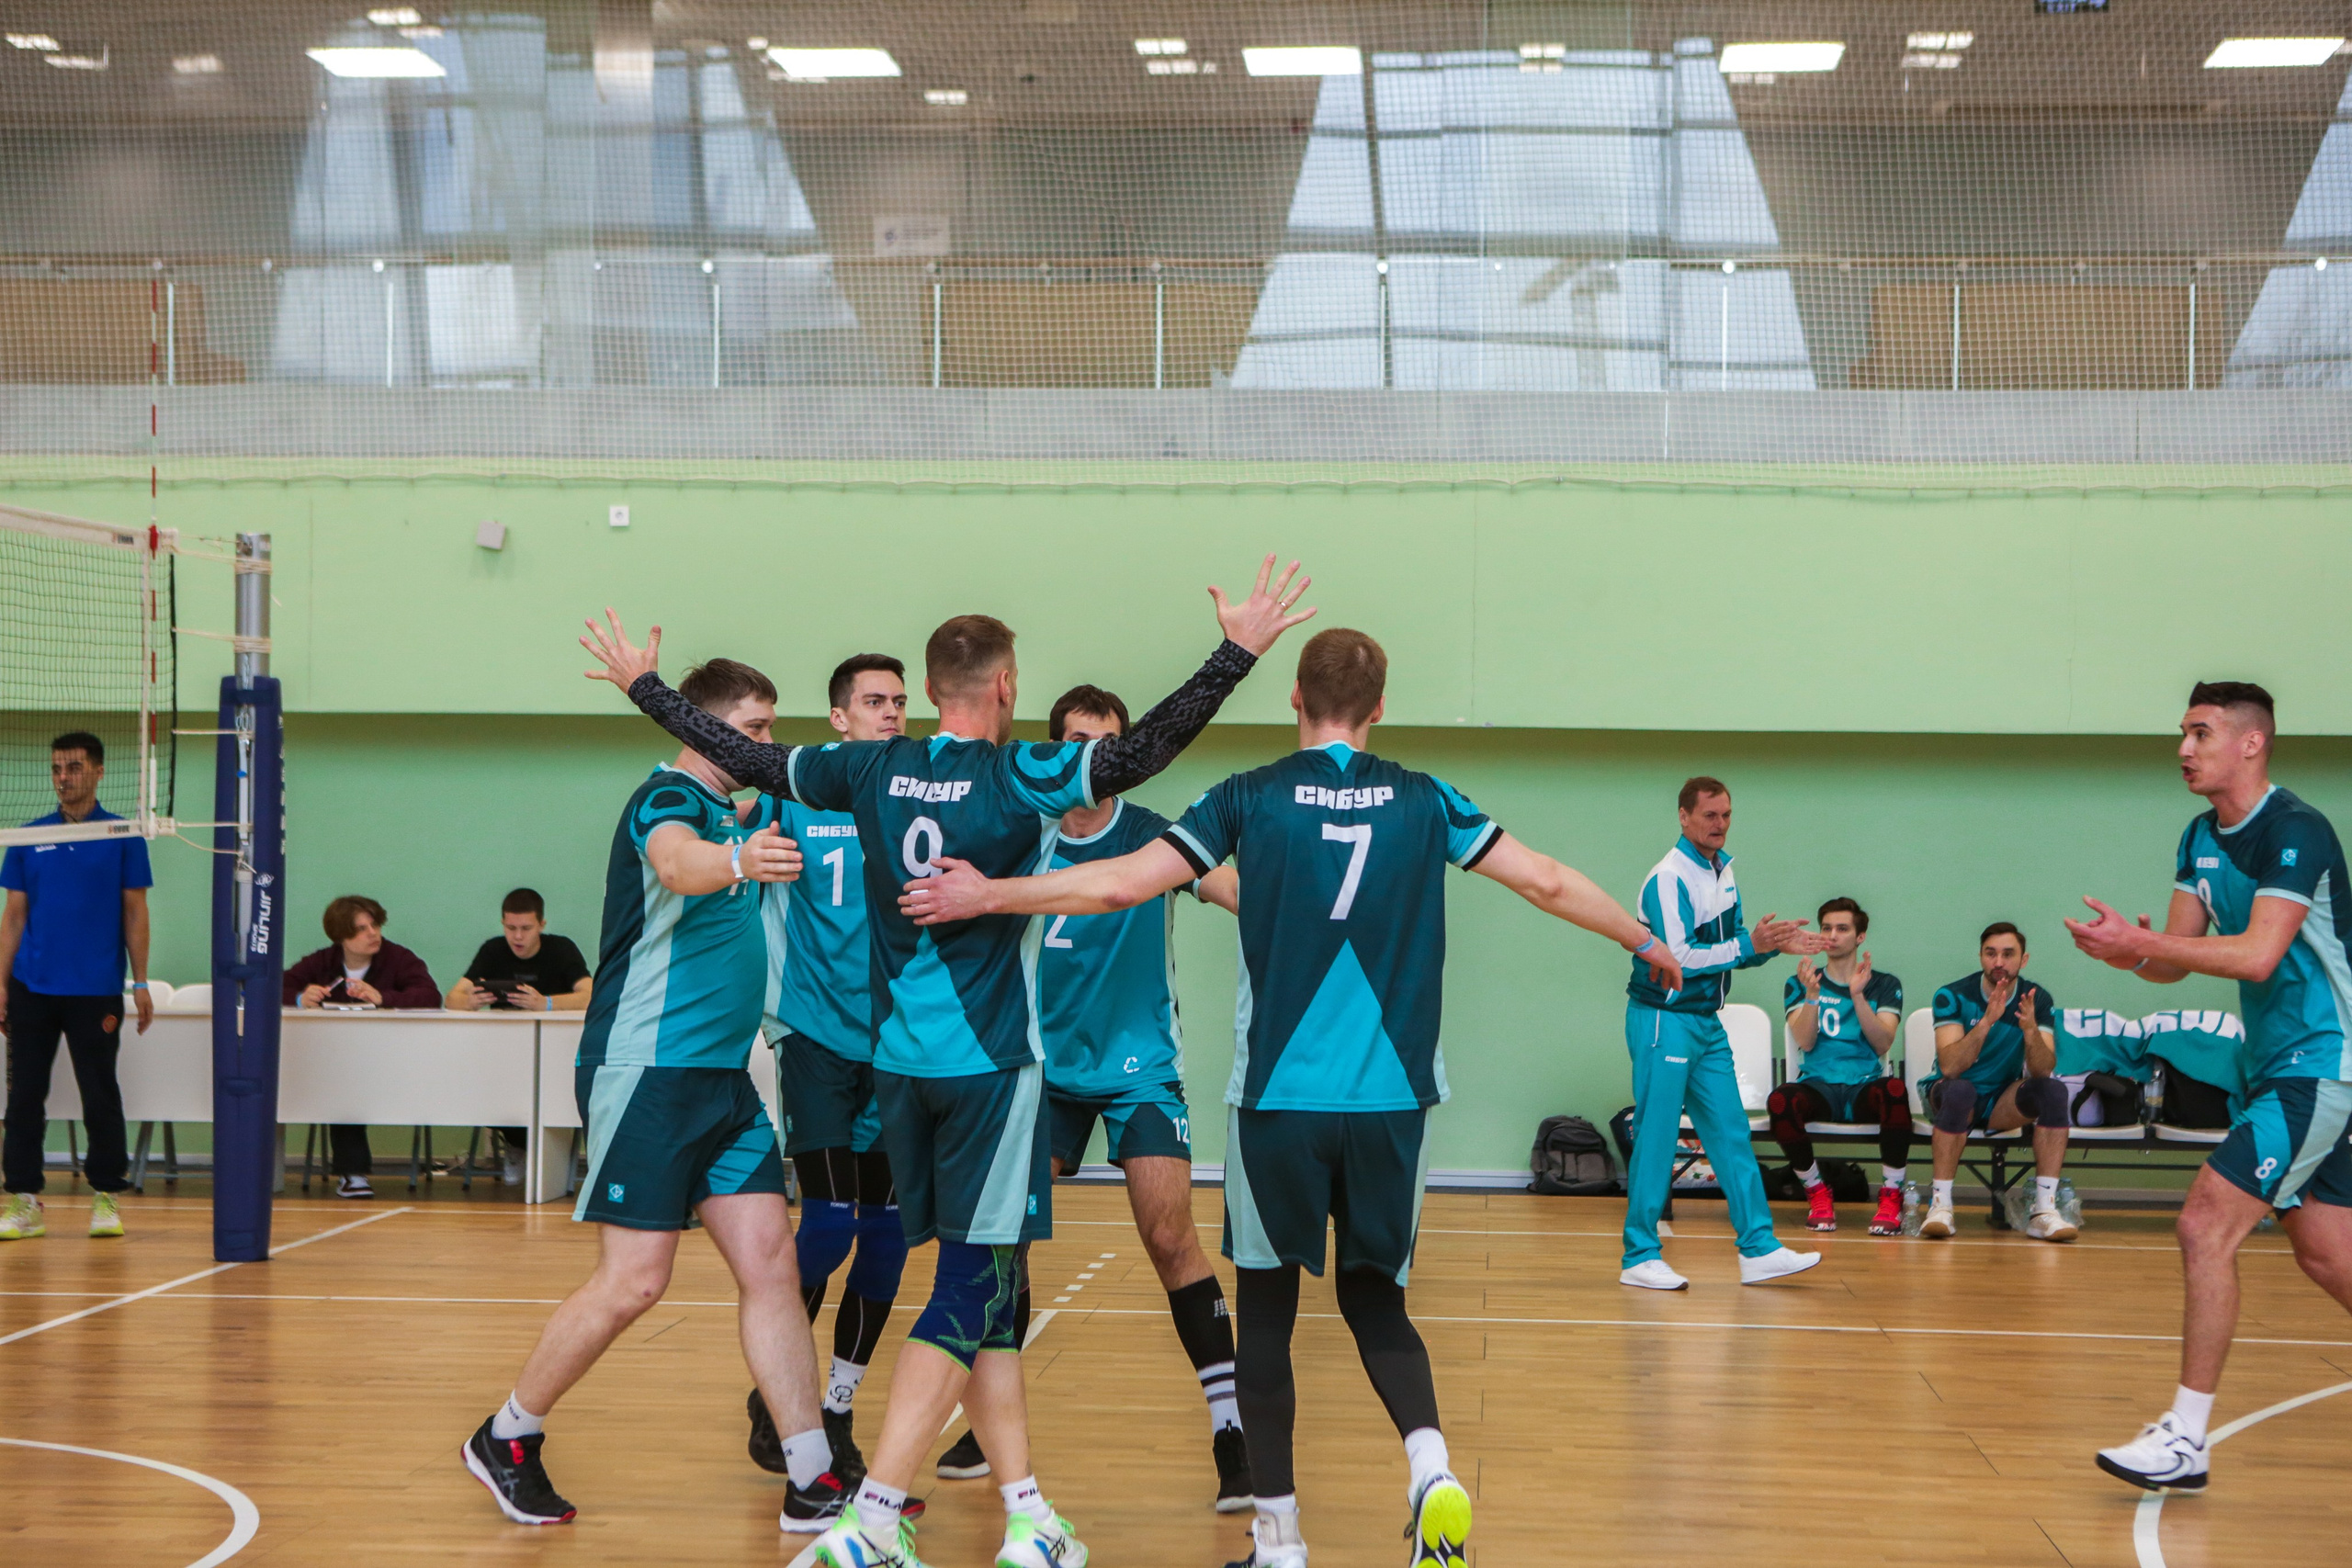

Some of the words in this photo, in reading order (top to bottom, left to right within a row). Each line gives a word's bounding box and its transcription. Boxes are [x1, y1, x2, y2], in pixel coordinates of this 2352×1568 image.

[1295, 785, 1394, 810] СИБУР
[823, 847, 843, 907] 1
[1322, 823, 1372, 920] 7
[1172, 1117, 1190, 1144] 12
[2255, 1157, 2278, 1179] 8
[865, 1491, 901, 1509] FILA
